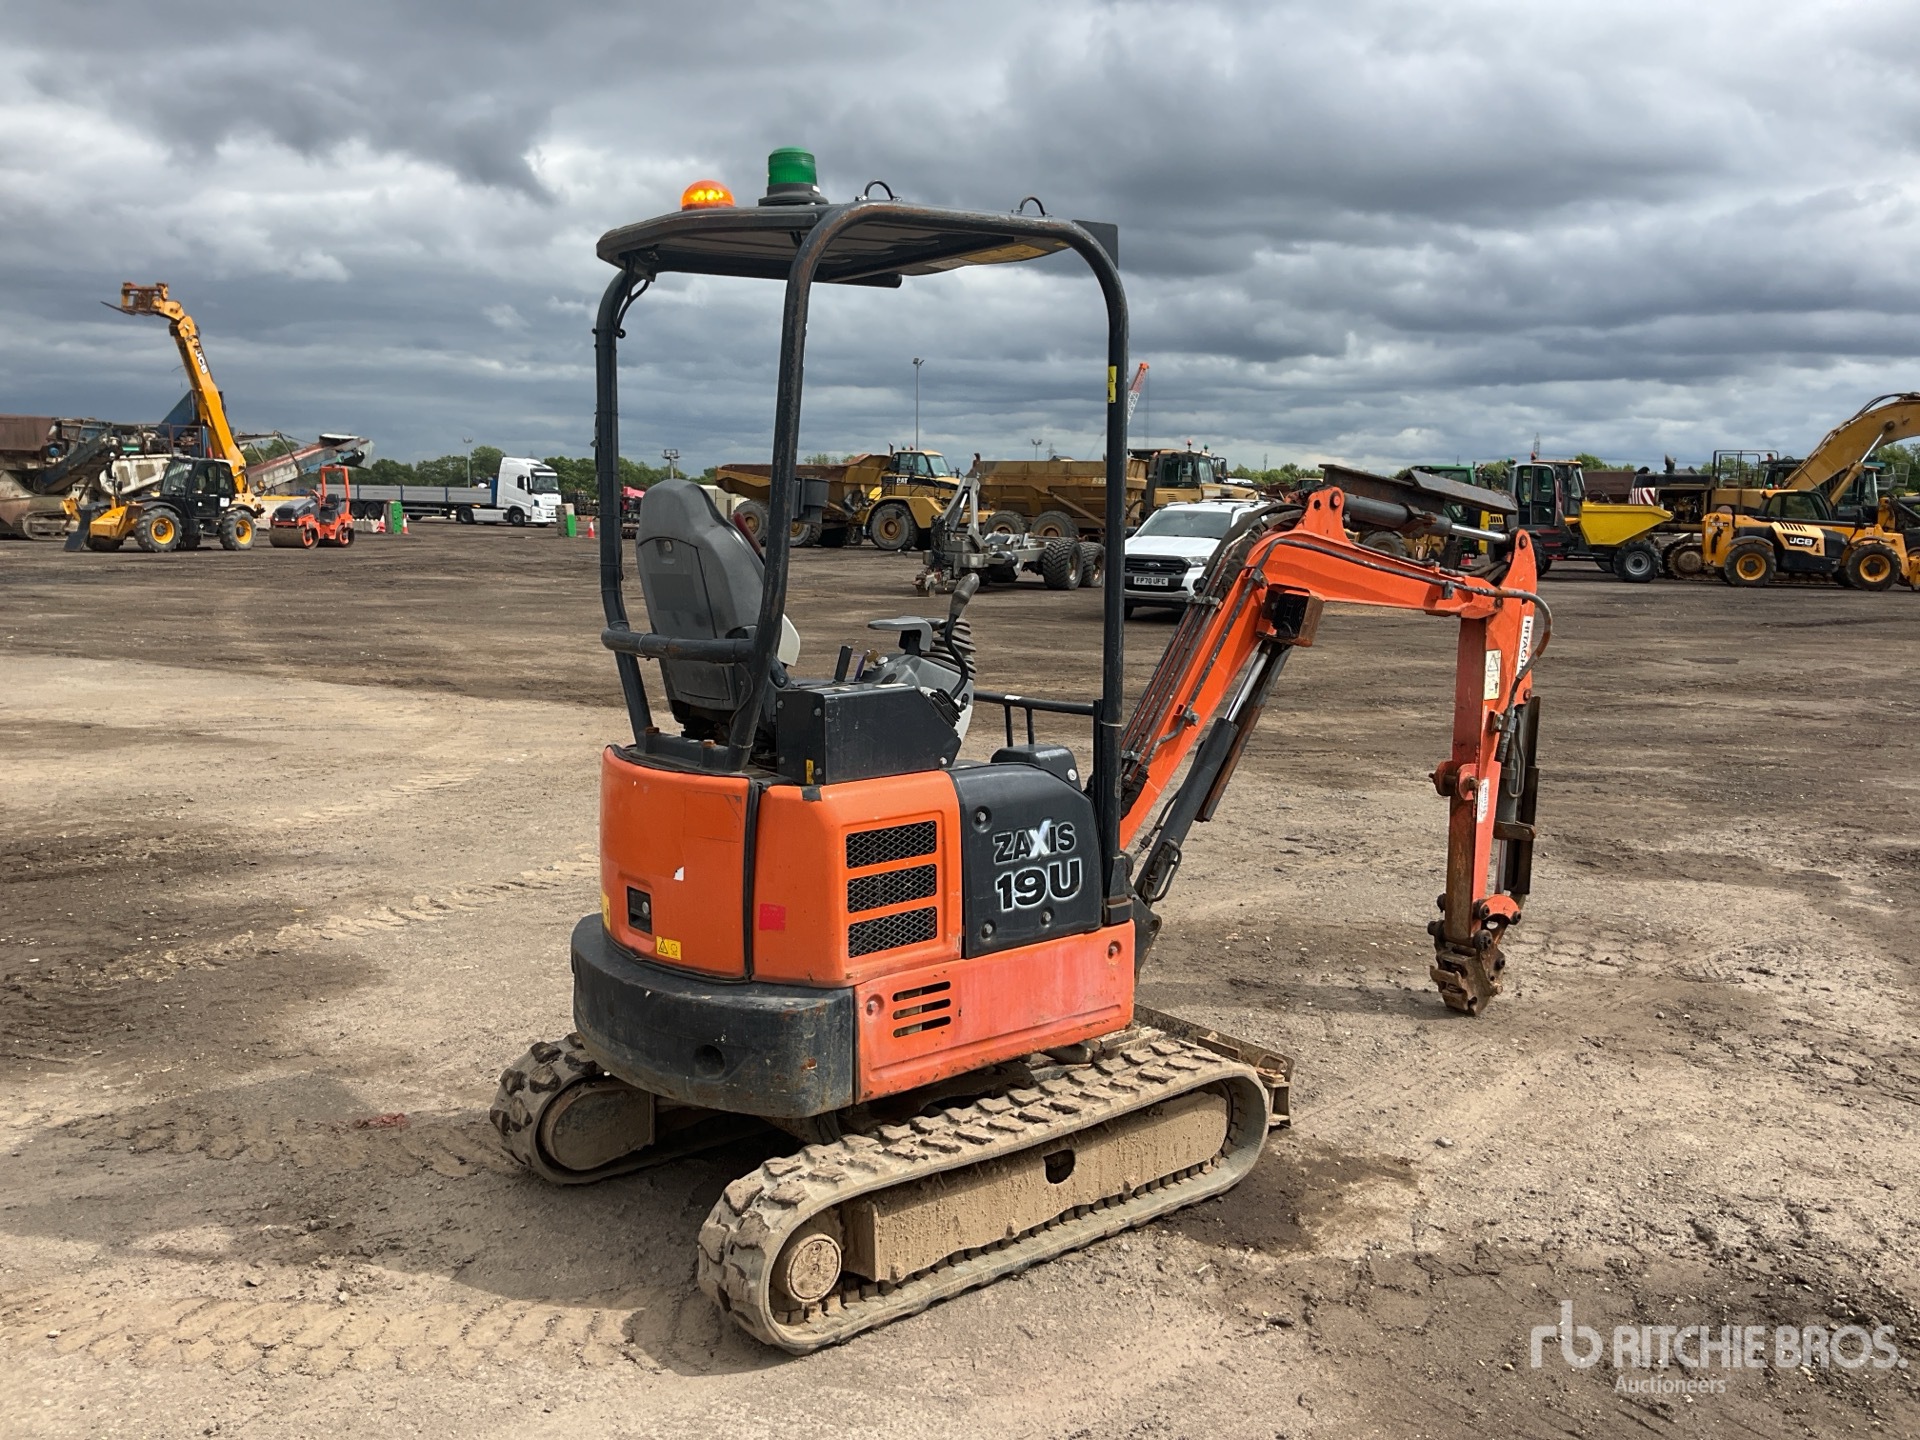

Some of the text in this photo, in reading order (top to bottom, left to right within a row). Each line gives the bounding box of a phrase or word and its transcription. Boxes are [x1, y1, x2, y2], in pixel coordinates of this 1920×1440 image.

[195, 350, 208, 374] JCB
[896, 477, 909, 485] CAT
[1789, 537, 1813, 546] JCB
[1136, 577, 1166, 585] FP70 UFC
[1519, 619, 1531, 671] HITACH
[993, 819, 1076, 864] ZAXIS
[995, 858, 1082, 912] 19U
